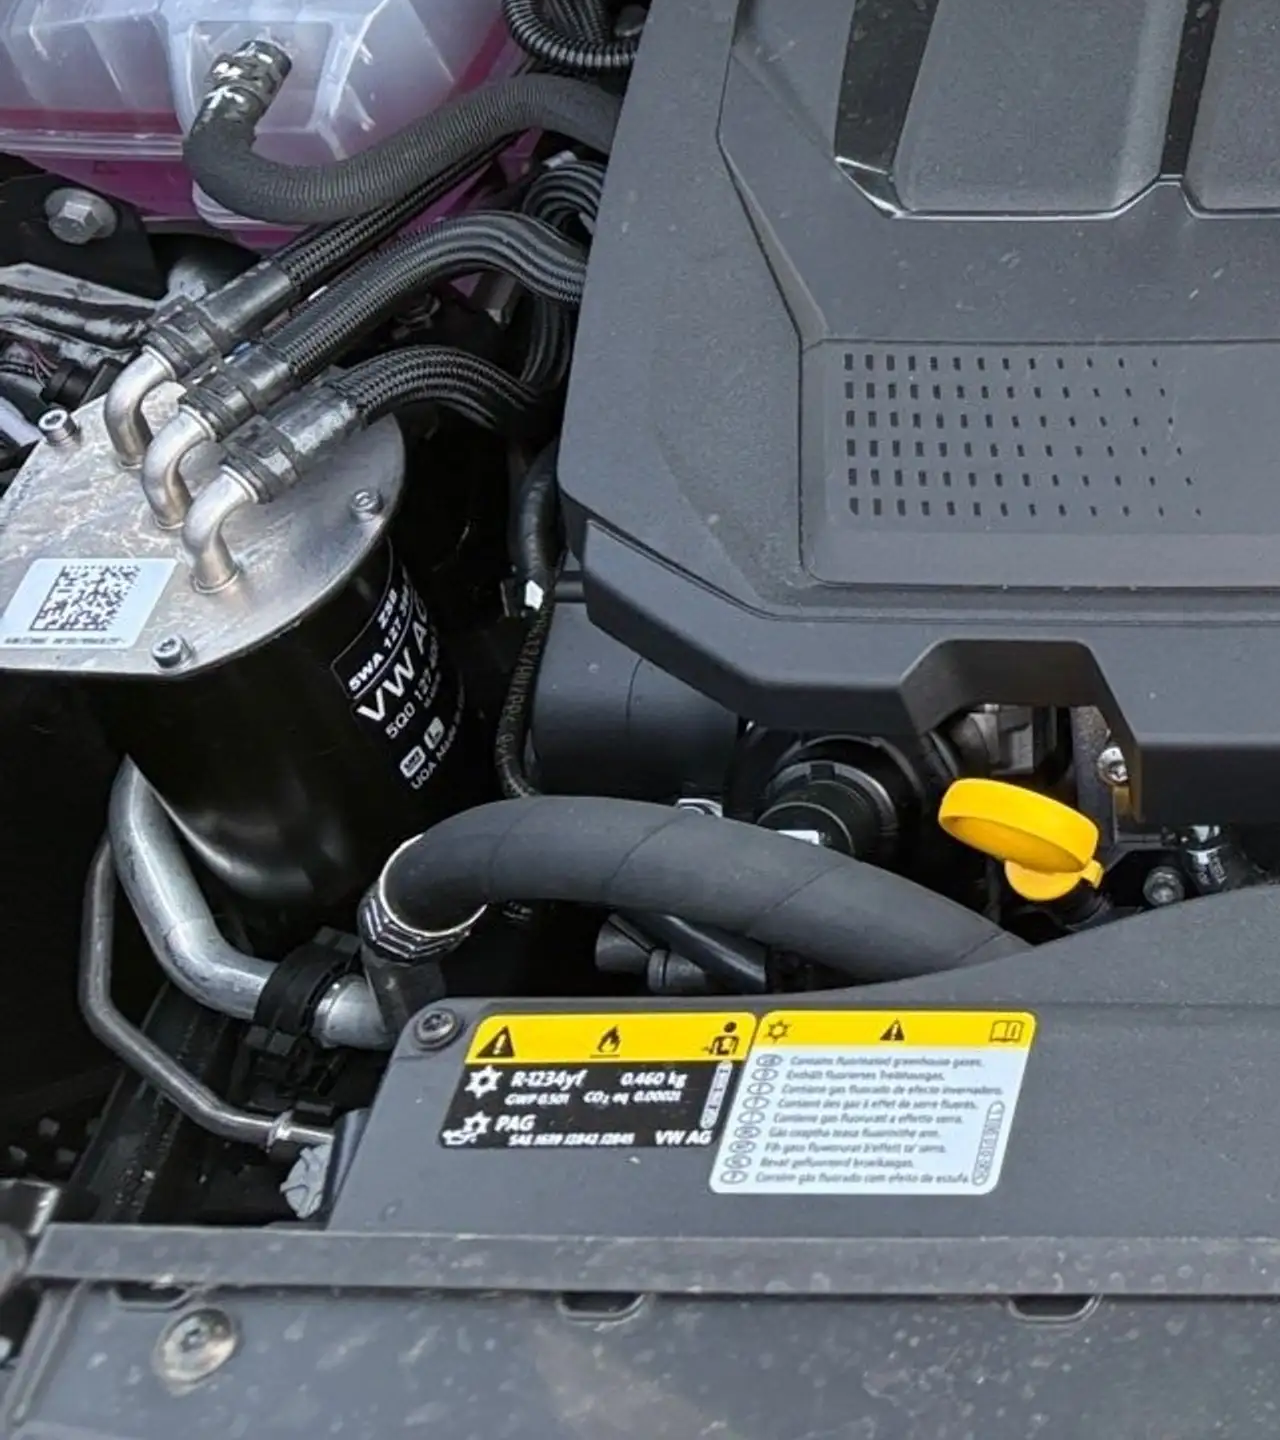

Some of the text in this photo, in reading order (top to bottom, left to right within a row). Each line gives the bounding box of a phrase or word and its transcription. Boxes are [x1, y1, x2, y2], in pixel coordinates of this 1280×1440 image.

[349, 652, 384, 691] 5WA
[356, 646, 415, 722] VW
[510, 1068, 688, 1091] R-1234yf 0.460 kg
[494, 1114, 537, 1132] PAG
[655, 1130, 712, 1145] VW AG
